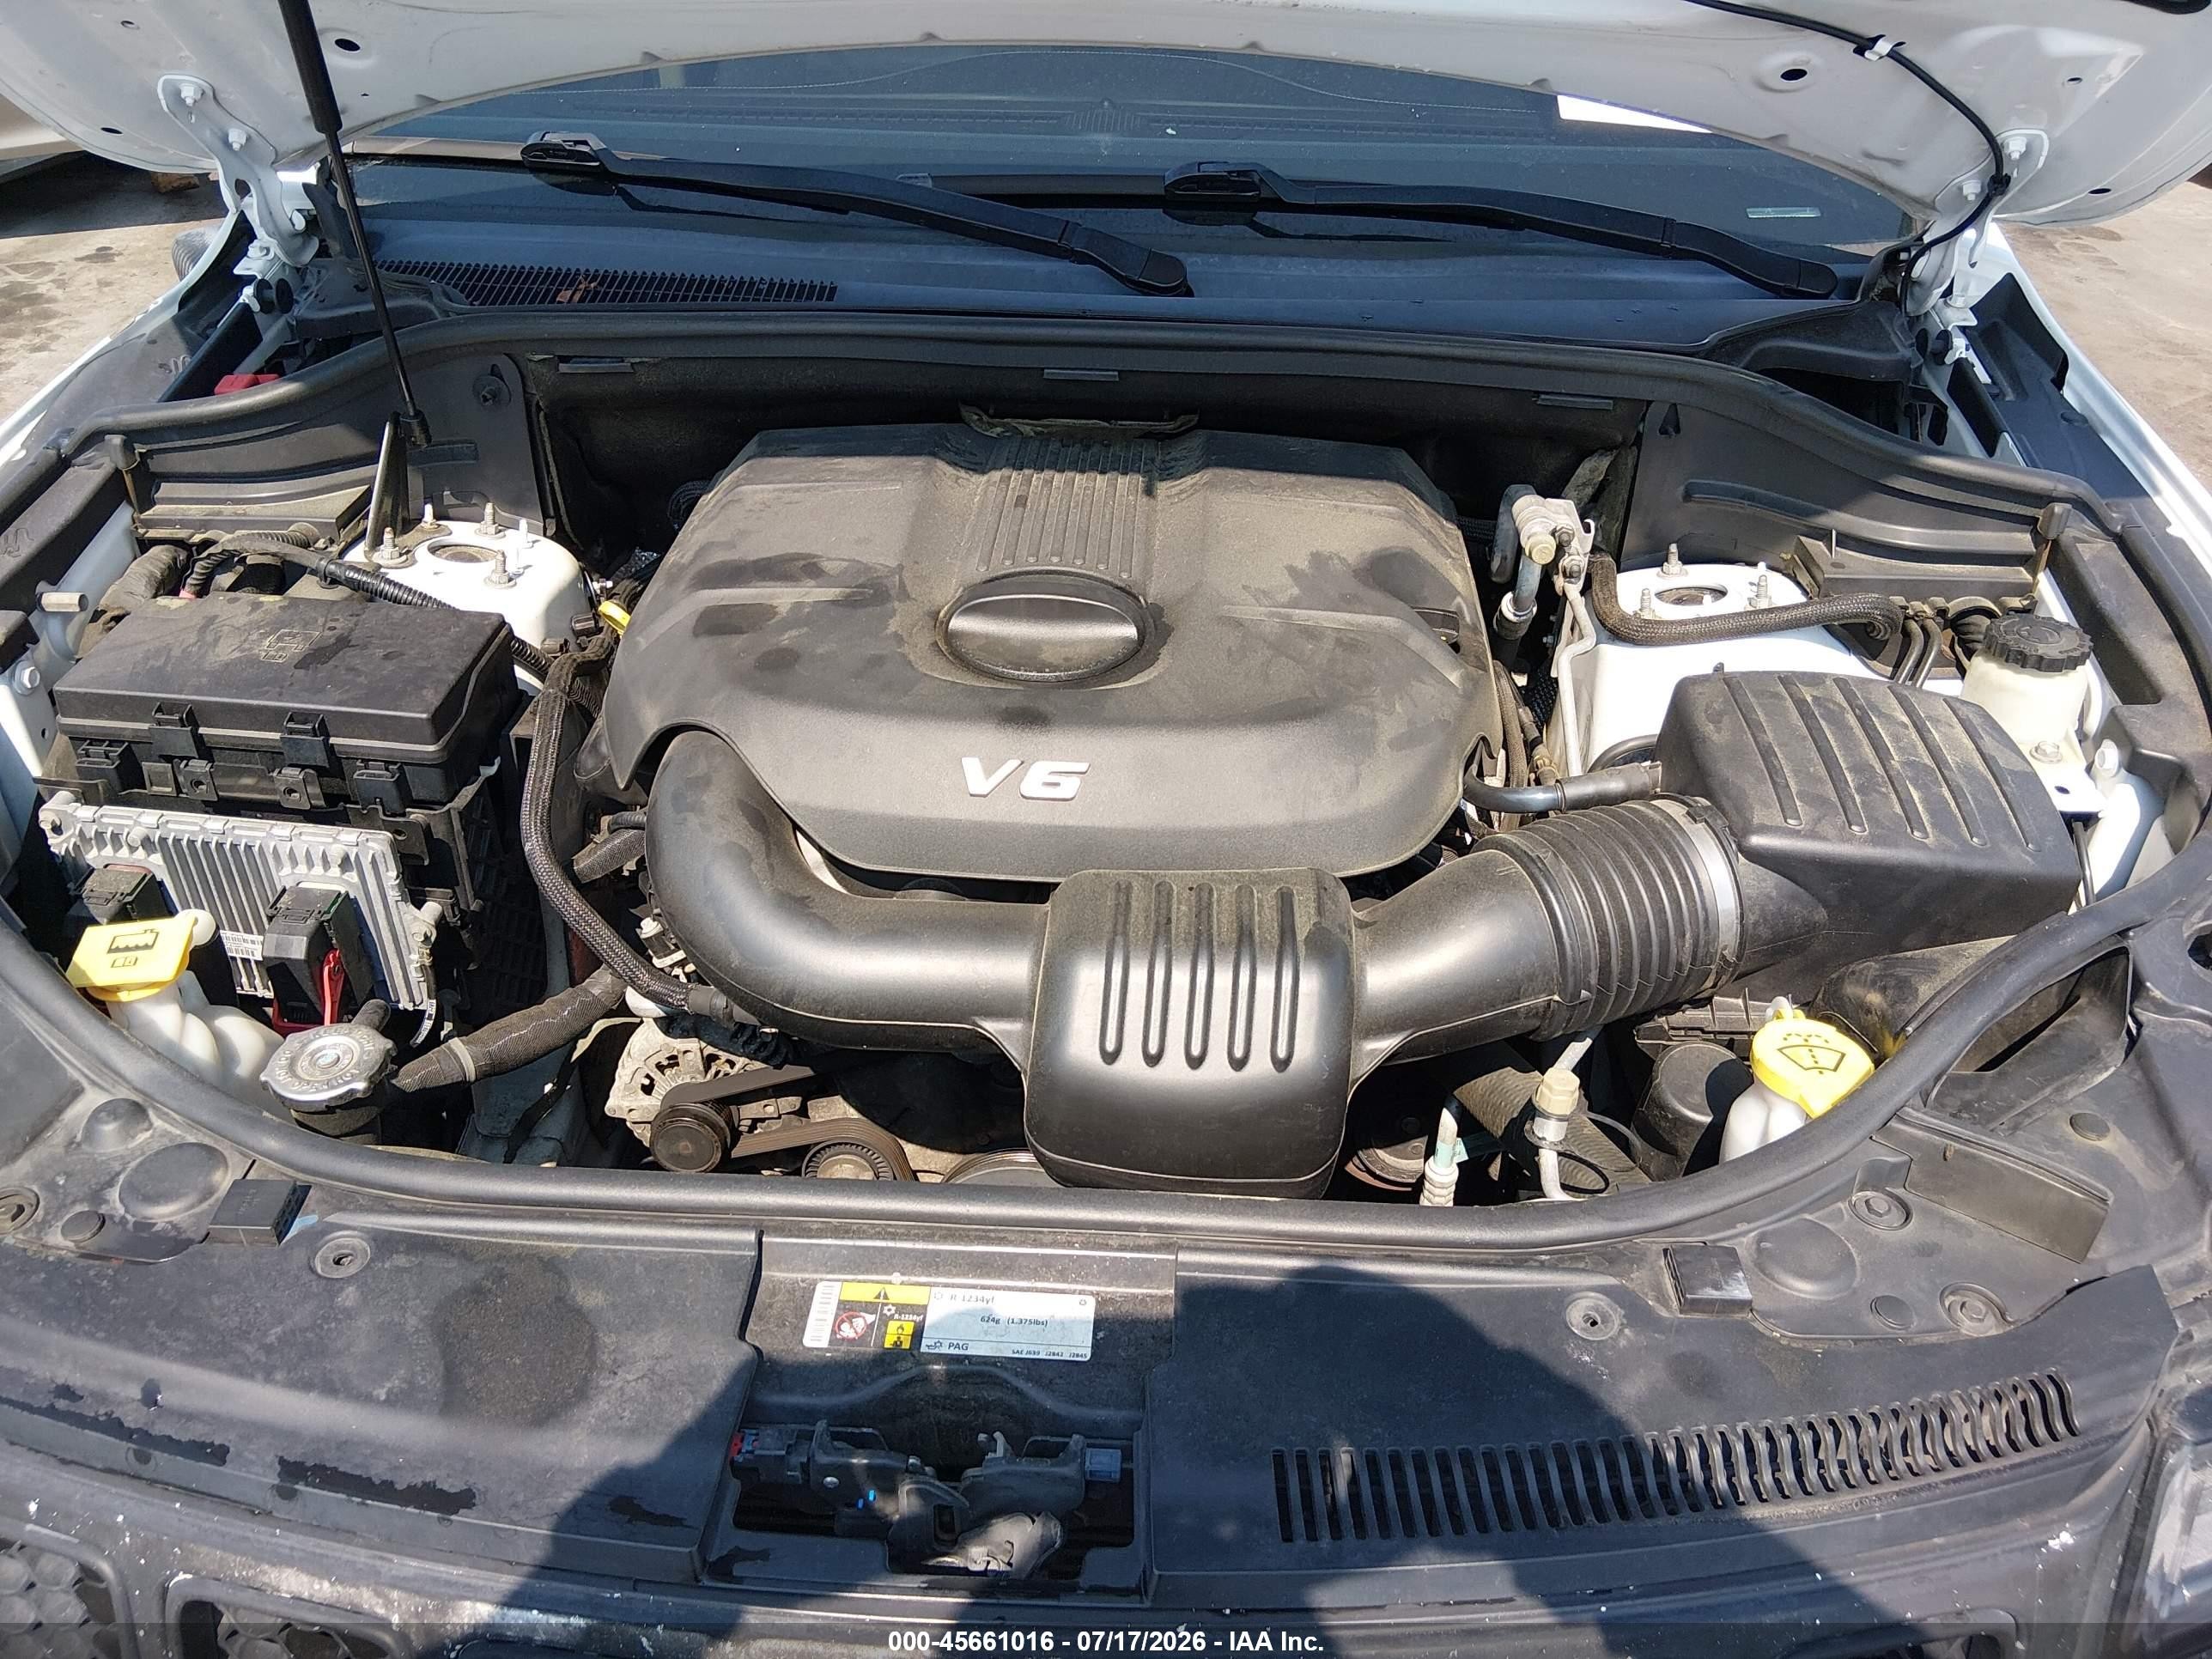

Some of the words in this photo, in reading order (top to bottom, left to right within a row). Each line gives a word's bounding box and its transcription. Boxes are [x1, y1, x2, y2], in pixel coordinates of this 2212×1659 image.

[961, 757, 1091, 801] V6
[950, 1294, 994, 1305] R1234yf
[980, 1316, 1000, 1325] 624g
[1007, 1316, 1048, 1328] (1.375lbs)
[948, 1341, 969, 1351] PAG
